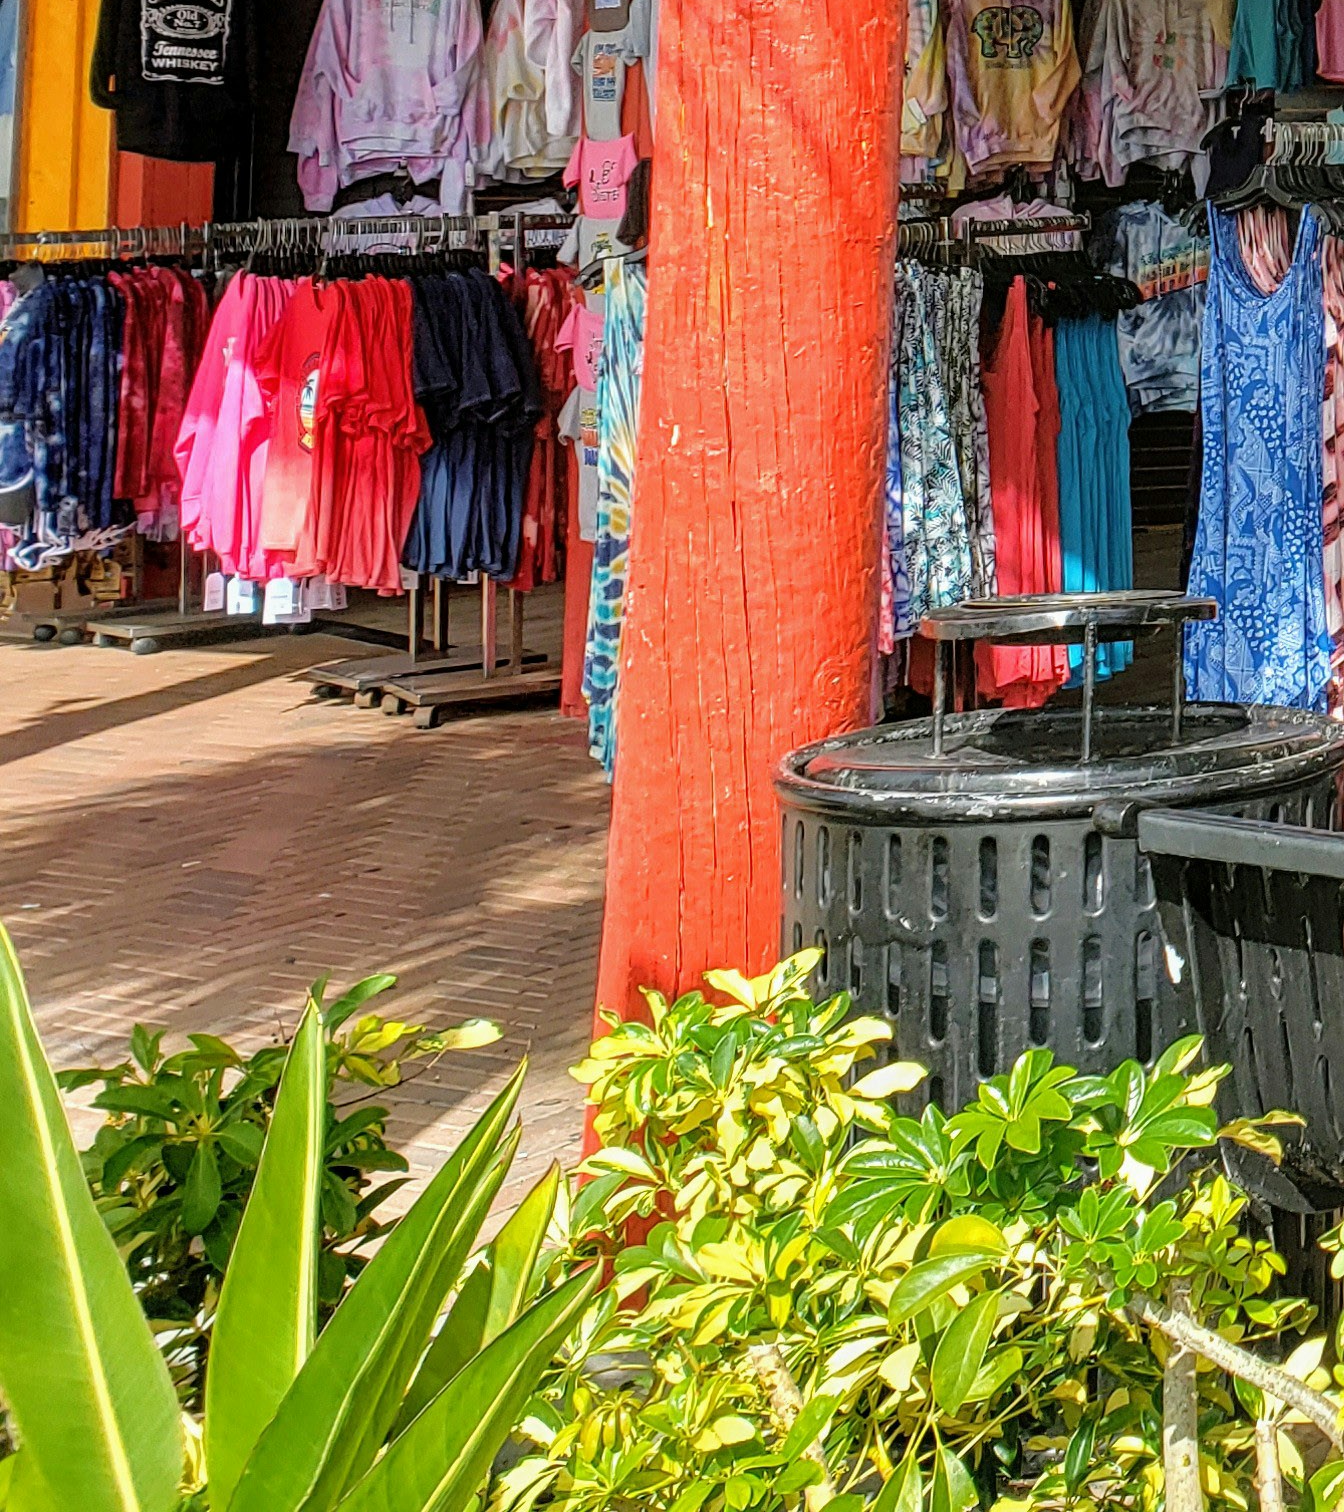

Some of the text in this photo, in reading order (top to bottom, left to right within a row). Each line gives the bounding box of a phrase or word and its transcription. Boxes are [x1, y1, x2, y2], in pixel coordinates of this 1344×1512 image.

[176, 9, 198, 21] Old
[152, 40, 218, 60] Tennessee
[151, 57, 219, 72] WHISKEY
